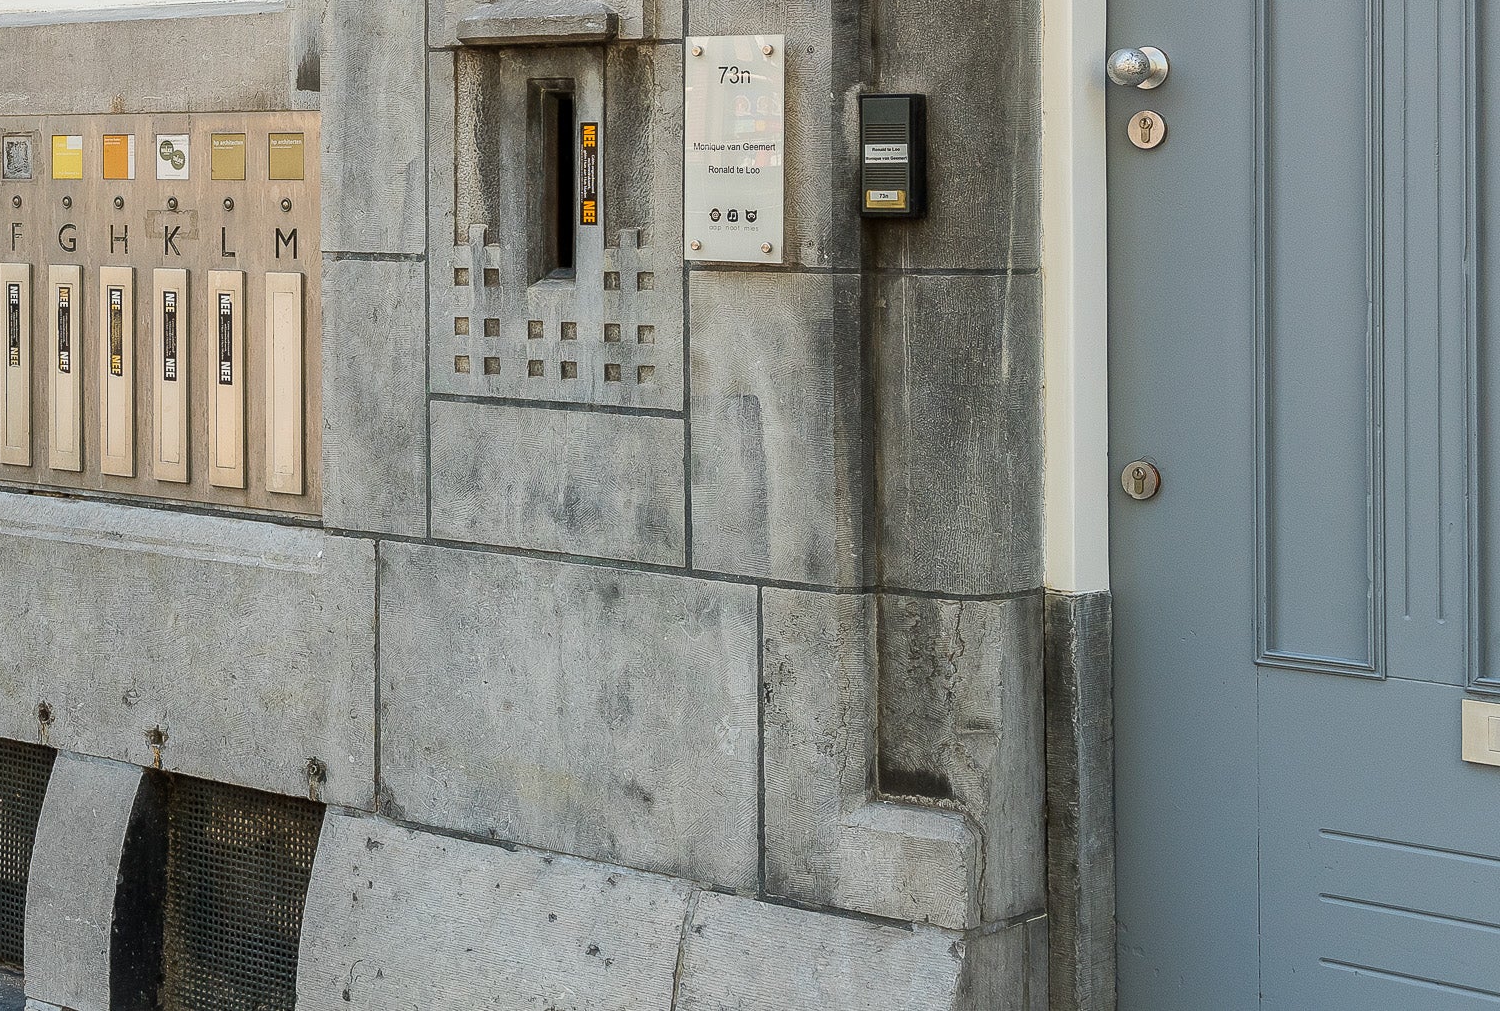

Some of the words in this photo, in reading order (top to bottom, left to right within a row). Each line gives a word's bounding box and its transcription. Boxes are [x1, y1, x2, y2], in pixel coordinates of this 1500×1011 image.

[718, 66, 750, 84] 73n
[583, 125, 596, 148] NEE
[693, 143, 725, 152] Monique
[742, 143, 776, 151] Geemert
[708, 165, 735, 174] Ronald
[736, 166, 743, 174] te
[745, 166, 761, 174] Loo
[583, 200, 596, 223] NEE
[12, 222, 23, 251] F
[58, 223, 77, 252] G
[110, 225, 128, 254] H
[164, 226, 181, 256] K
[222, 227, 236, 257] L
[275, 228, 298, 259] M
[10, 286, 18, 305] NEE
[59, 288, 68, 308] NEE
[111, 291, 120, 310] NEE
[165, 293, 175, 313] NEE
[220, 296, 230, 315] NEE
[10, 347, 19, 366] NEE
[59, 351, 69, 371] NEE
[111, 355, 121, 374] NEE
[165, 358, 176, 378] NEE
[221, 361, 231, 382] NEE
